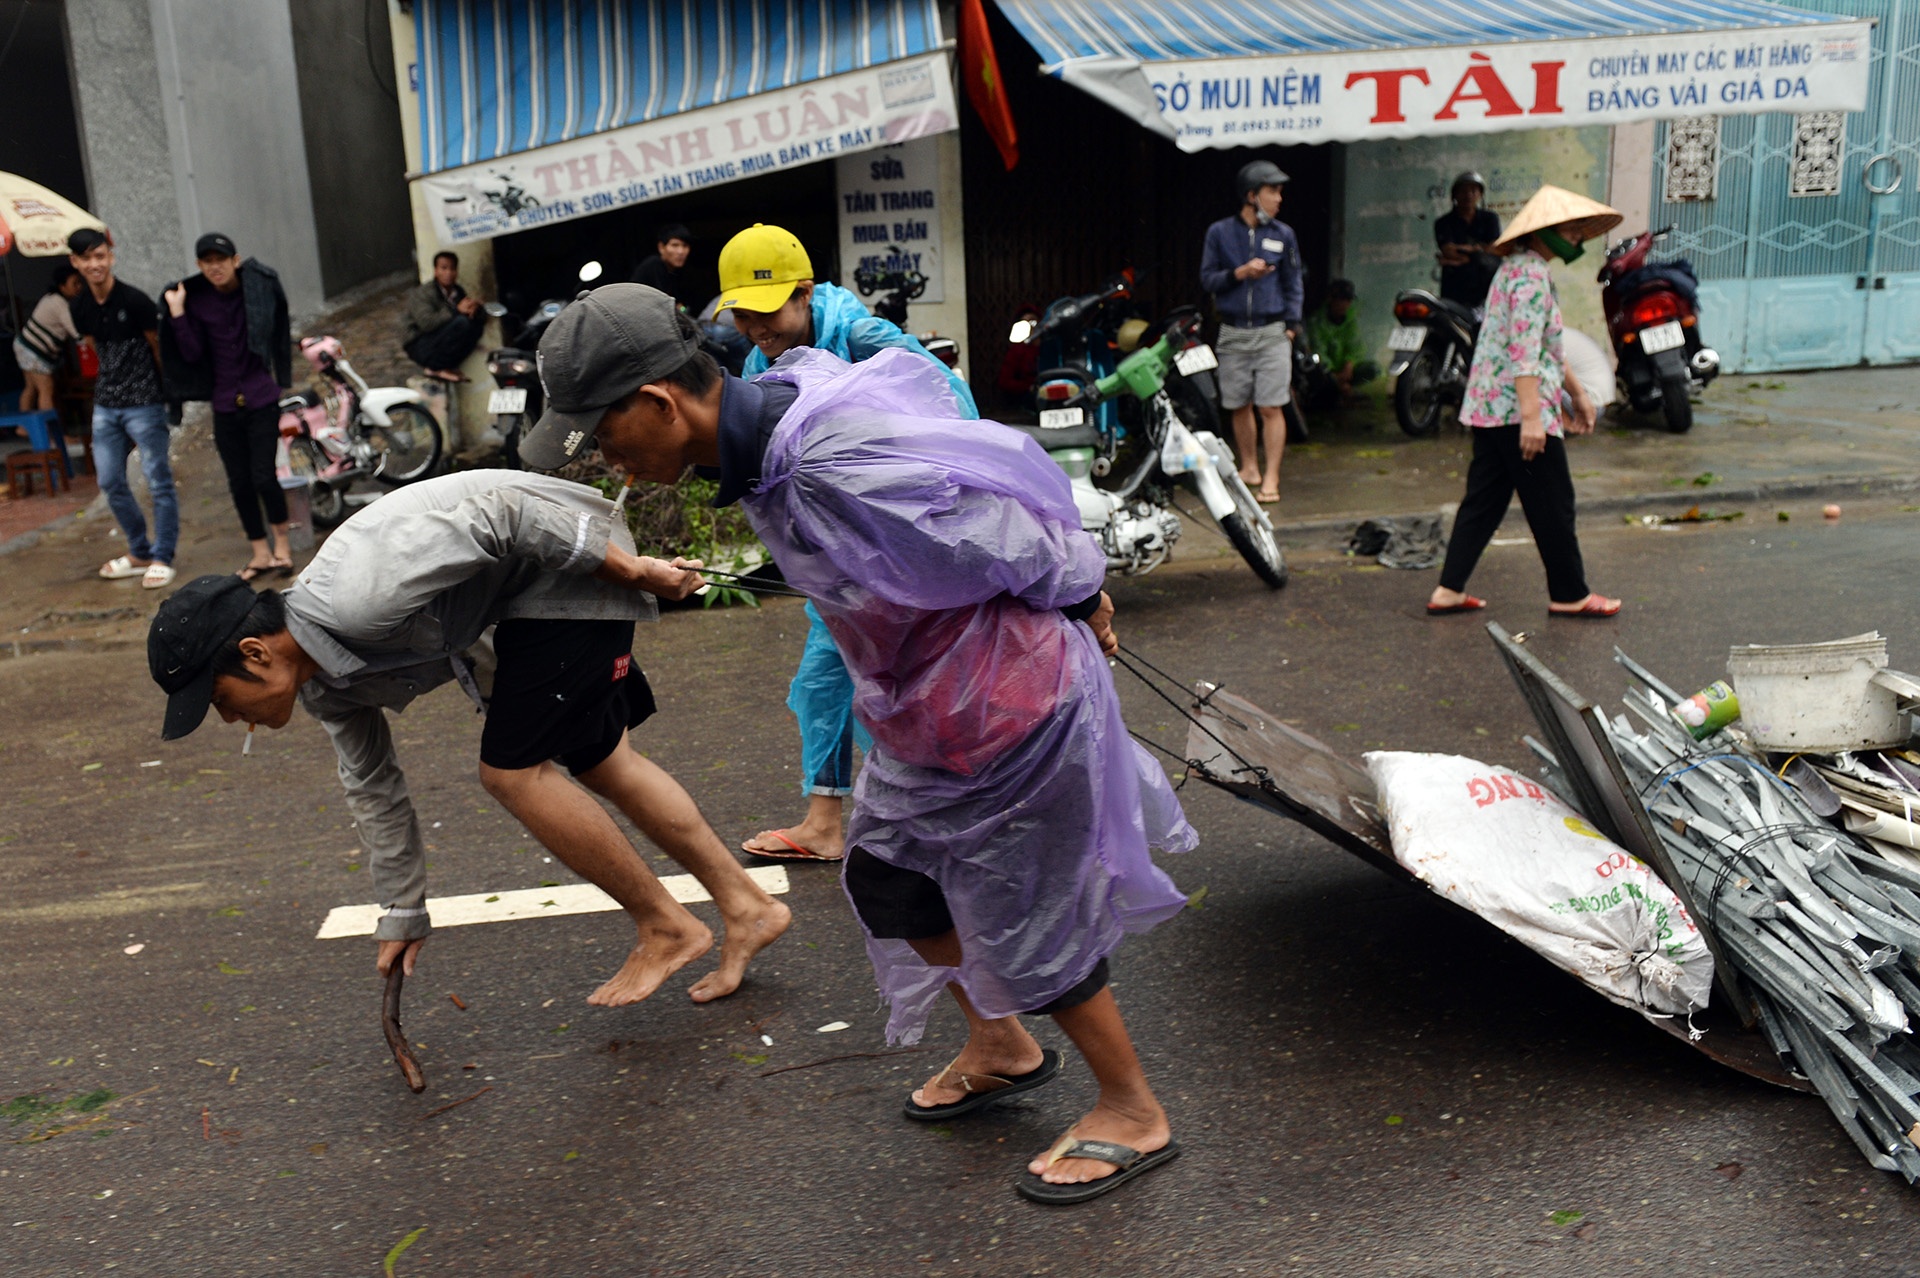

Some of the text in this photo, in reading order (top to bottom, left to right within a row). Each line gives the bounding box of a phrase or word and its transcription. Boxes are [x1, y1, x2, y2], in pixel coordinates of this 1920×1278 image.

[1588, 50, 1650, 78] CHUYÊN
[1657, 51, 1689, 74] MAY
[1694, 44, 1728, 71] CÁC
[1152, 66, 1322, 112] SỞ MUI NỆM
[1343, 51, 1566, 125] TÀI
[1669, 76, 1708, 106] VẢI
[1720, 73, 1764, 104] GIẢ
[1774, 76, 1809, 99] DA
[533, 126, 713, 198] THÀNH
[725, 84, 870, 153] LUÂN
[779, 142, 811, 165] BÁN
[815, 136, 836, 155] XE
[840, 126, 873, 149] MÁY
[870, 154, 905, 180] SỬA
[844, 189, 935, 213] TÂN TRANG
[852, 218, 928, 243] MUA BÁN
[859, 252, 922, 272] XE MÁY
